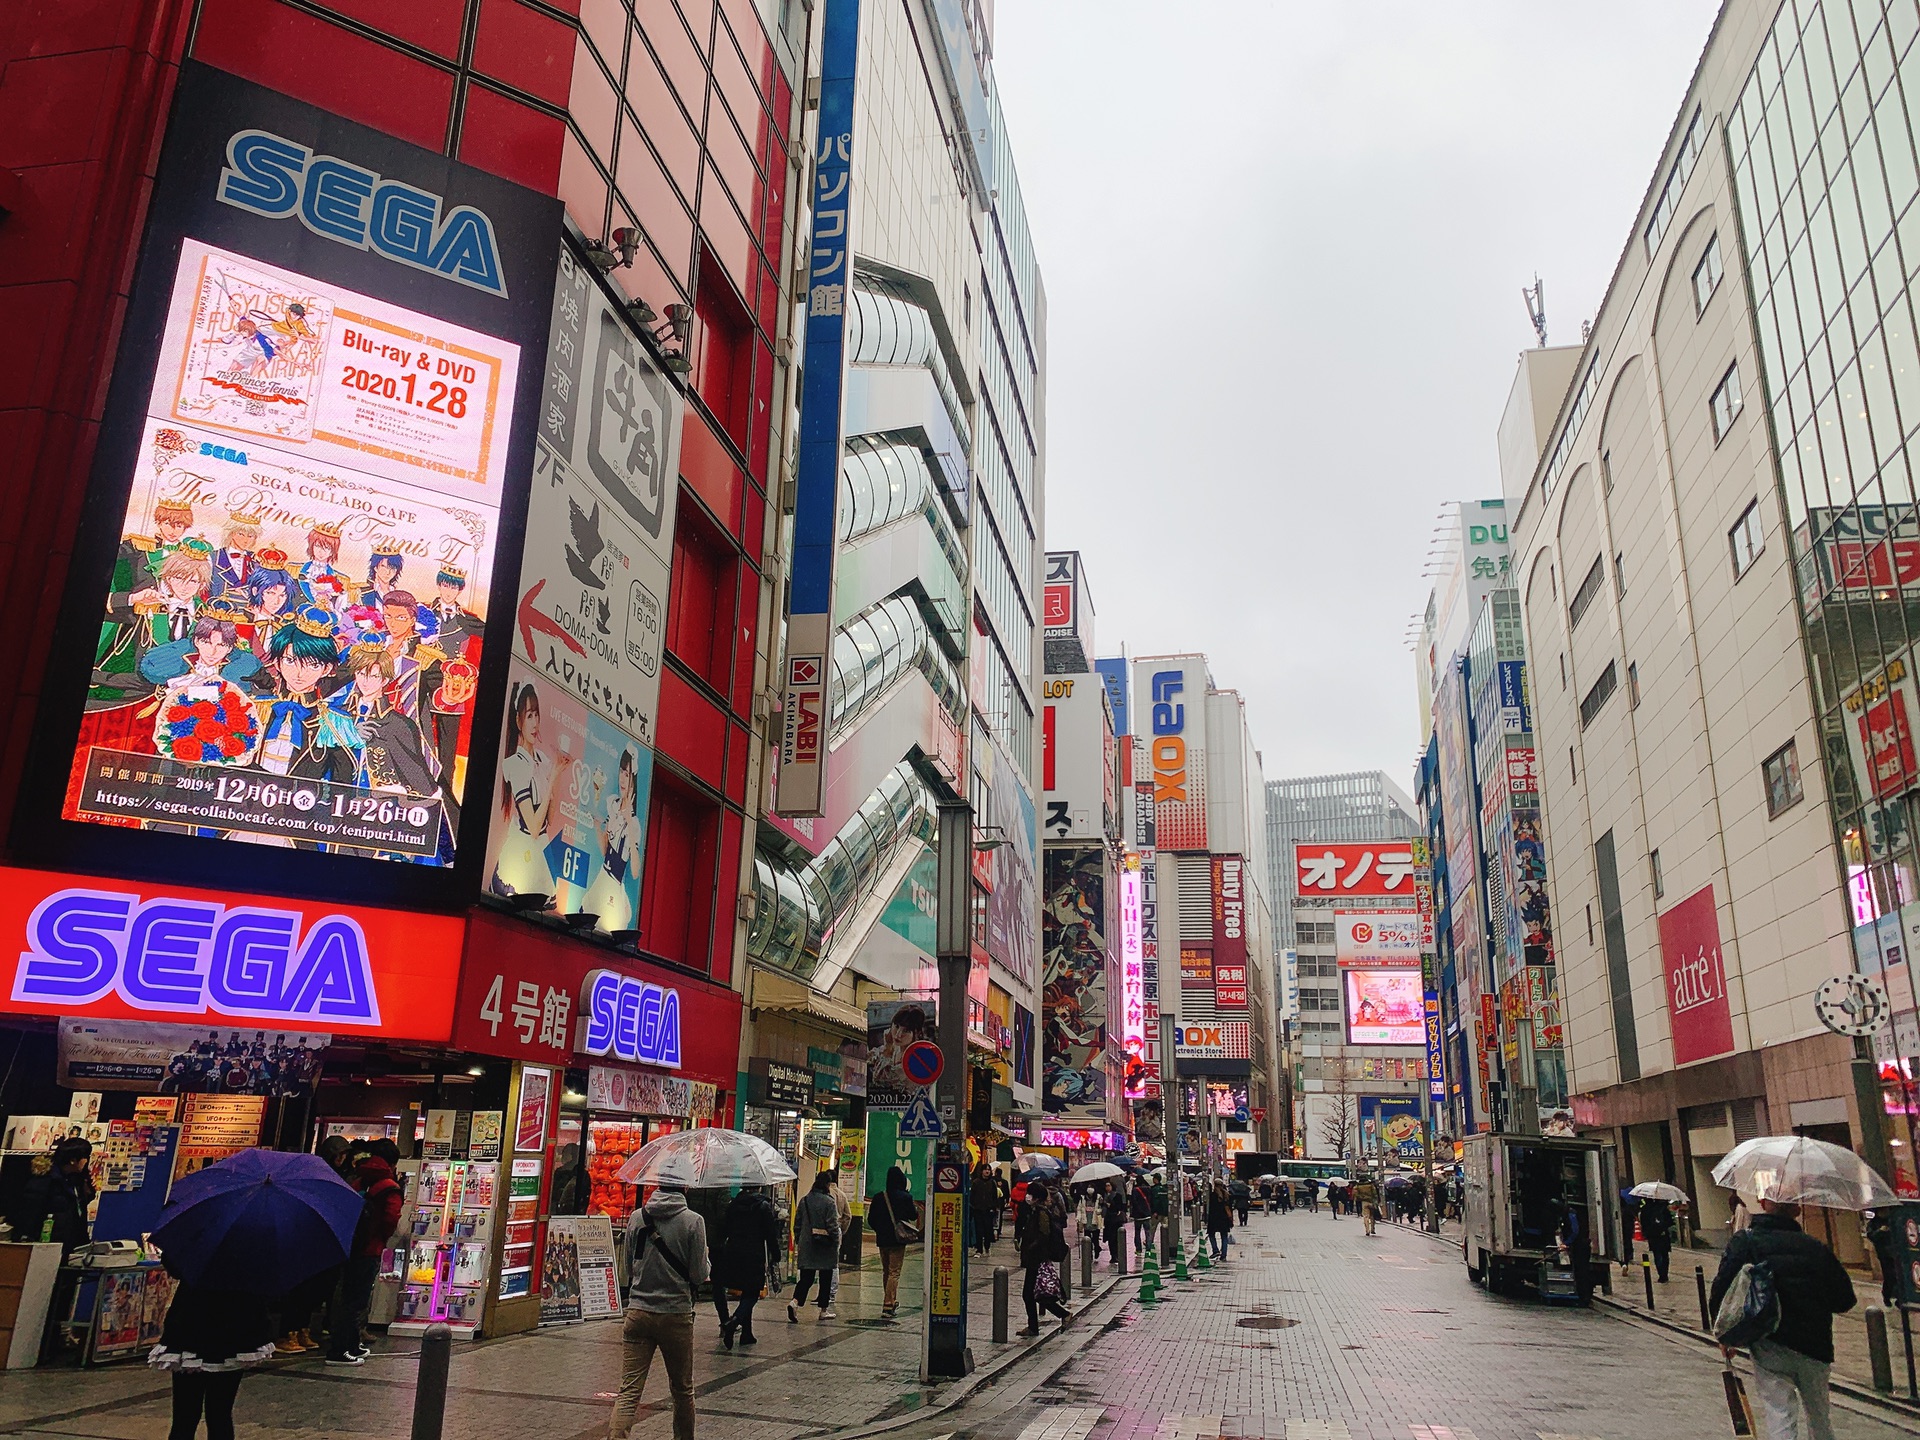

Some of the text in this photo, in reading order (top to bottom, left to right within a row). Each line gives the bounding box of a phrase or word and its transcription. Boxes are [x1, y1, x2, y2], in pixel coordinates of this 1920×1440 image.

[215, 128, 510, 299] SEGA
[809, 133, 851, 317] パソコン館
[560, 249, 588, 291] 8F
[343, 329, 411, 367] Blu-ray
[417, 353, 430, 371] &
[437, 358, 476, 384] DVD
[546, 289, 579, 442] 焼肉酒家
[229, 370, 267, 388] Prince
[268, 380, 299, 398] Tennis
[341, 366, 468, 419] 2020.1.28
[199, 441, 248, 466] SEGA
[536, 444, 566, 488] 7F
[161, 467, 217, 507] The
[224, 485, 318, 530] Prince
[348, 513, 429, 558] Tennis
[250, 472, 418, 524] SEGA COLLABO CAFE
[554, 604, 620, 670] DOMA-DOMA
[632, 601, 658, 635] 16:00
[545, 645, 653, 743] 入口はこちらです。
[1503, 663, 1515, 706] レオパレス21
[783, 692, 797, 765] AKIHABARA
[796, 692, 820, 764] LABI
[1504, 718, 1519, 728] 7F
[99, 765, 164, 785] 開催期間
[1512, 780, 1525, 790] 6F
[95, 789, 427, 846] https://sega-collabocafe.com/top/tenipuri.html
[1137, 785, 1146, 843] PARADISE
[1144, 785, 1154, 825] HOBBY
[562, 847, 581, 881] 6F
[911, 878, 937, 921] TSU
[1213, 860, 1223, 920] Flagship Store
[1221, 860, 1243, 939] Duty Free
[1379, 931, 1408, 942] 5%
[1421, 914, 1433, 944] 耳かき
[10, 888, 382, 1027] SEGA
[1218, 969, 1243, 981] 免税
[1673, 944, 1712, 1009] atré
[480, 974, 571, 1051] 4号館
[587, 969, 682, 1069] SEGA
[1218, 990, 1245, 1001] 면세점
[67, 1043, 82, 1056] The
[83, 1044, 117, 1057] Prince
[1204, 1047, 1223, 1055] Store
[768, 1063, 813, 1086] Digital Headphone
[868, 1093, 912, 1105] 2020.1.22
[940, 1202, 954, 1311] 路上喫煙禁止です。
